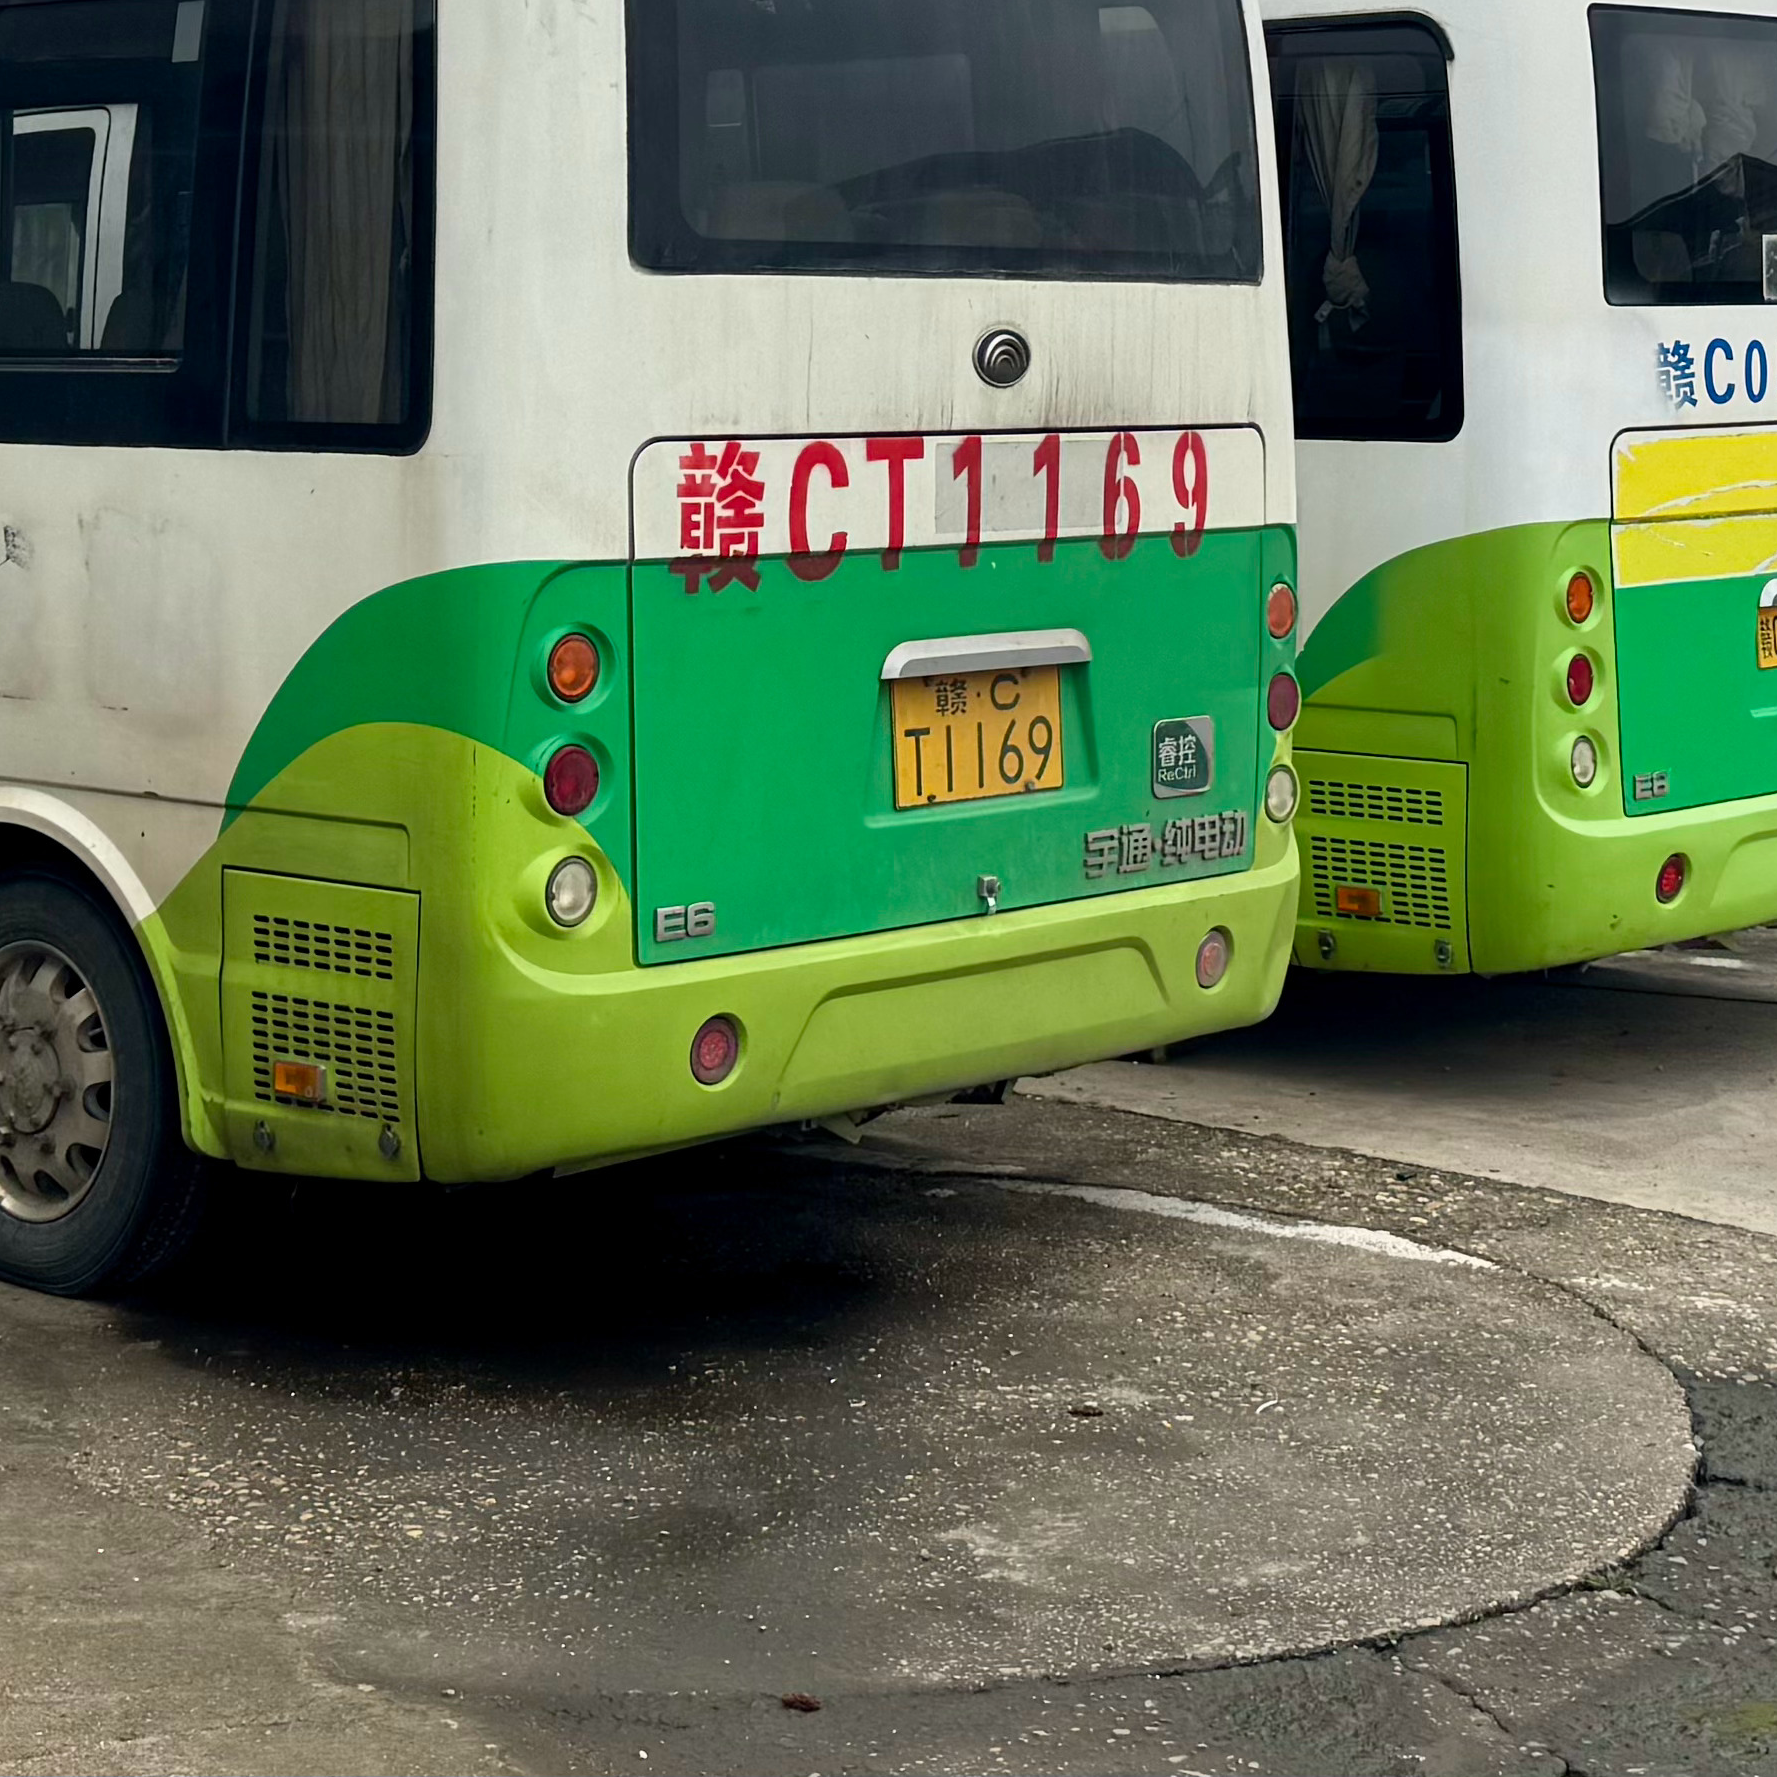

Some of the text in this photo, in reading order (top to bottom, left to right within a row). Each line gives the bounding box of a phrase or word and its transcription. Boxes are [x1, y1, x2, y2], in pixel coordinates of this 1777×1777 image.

[668, 431, 1208, 595] 赣CT1169
[904, 715, 1053, 797] T1169
[1158, 734, 1197, 767] 睿控
[656, 902, 714, 942] E6
